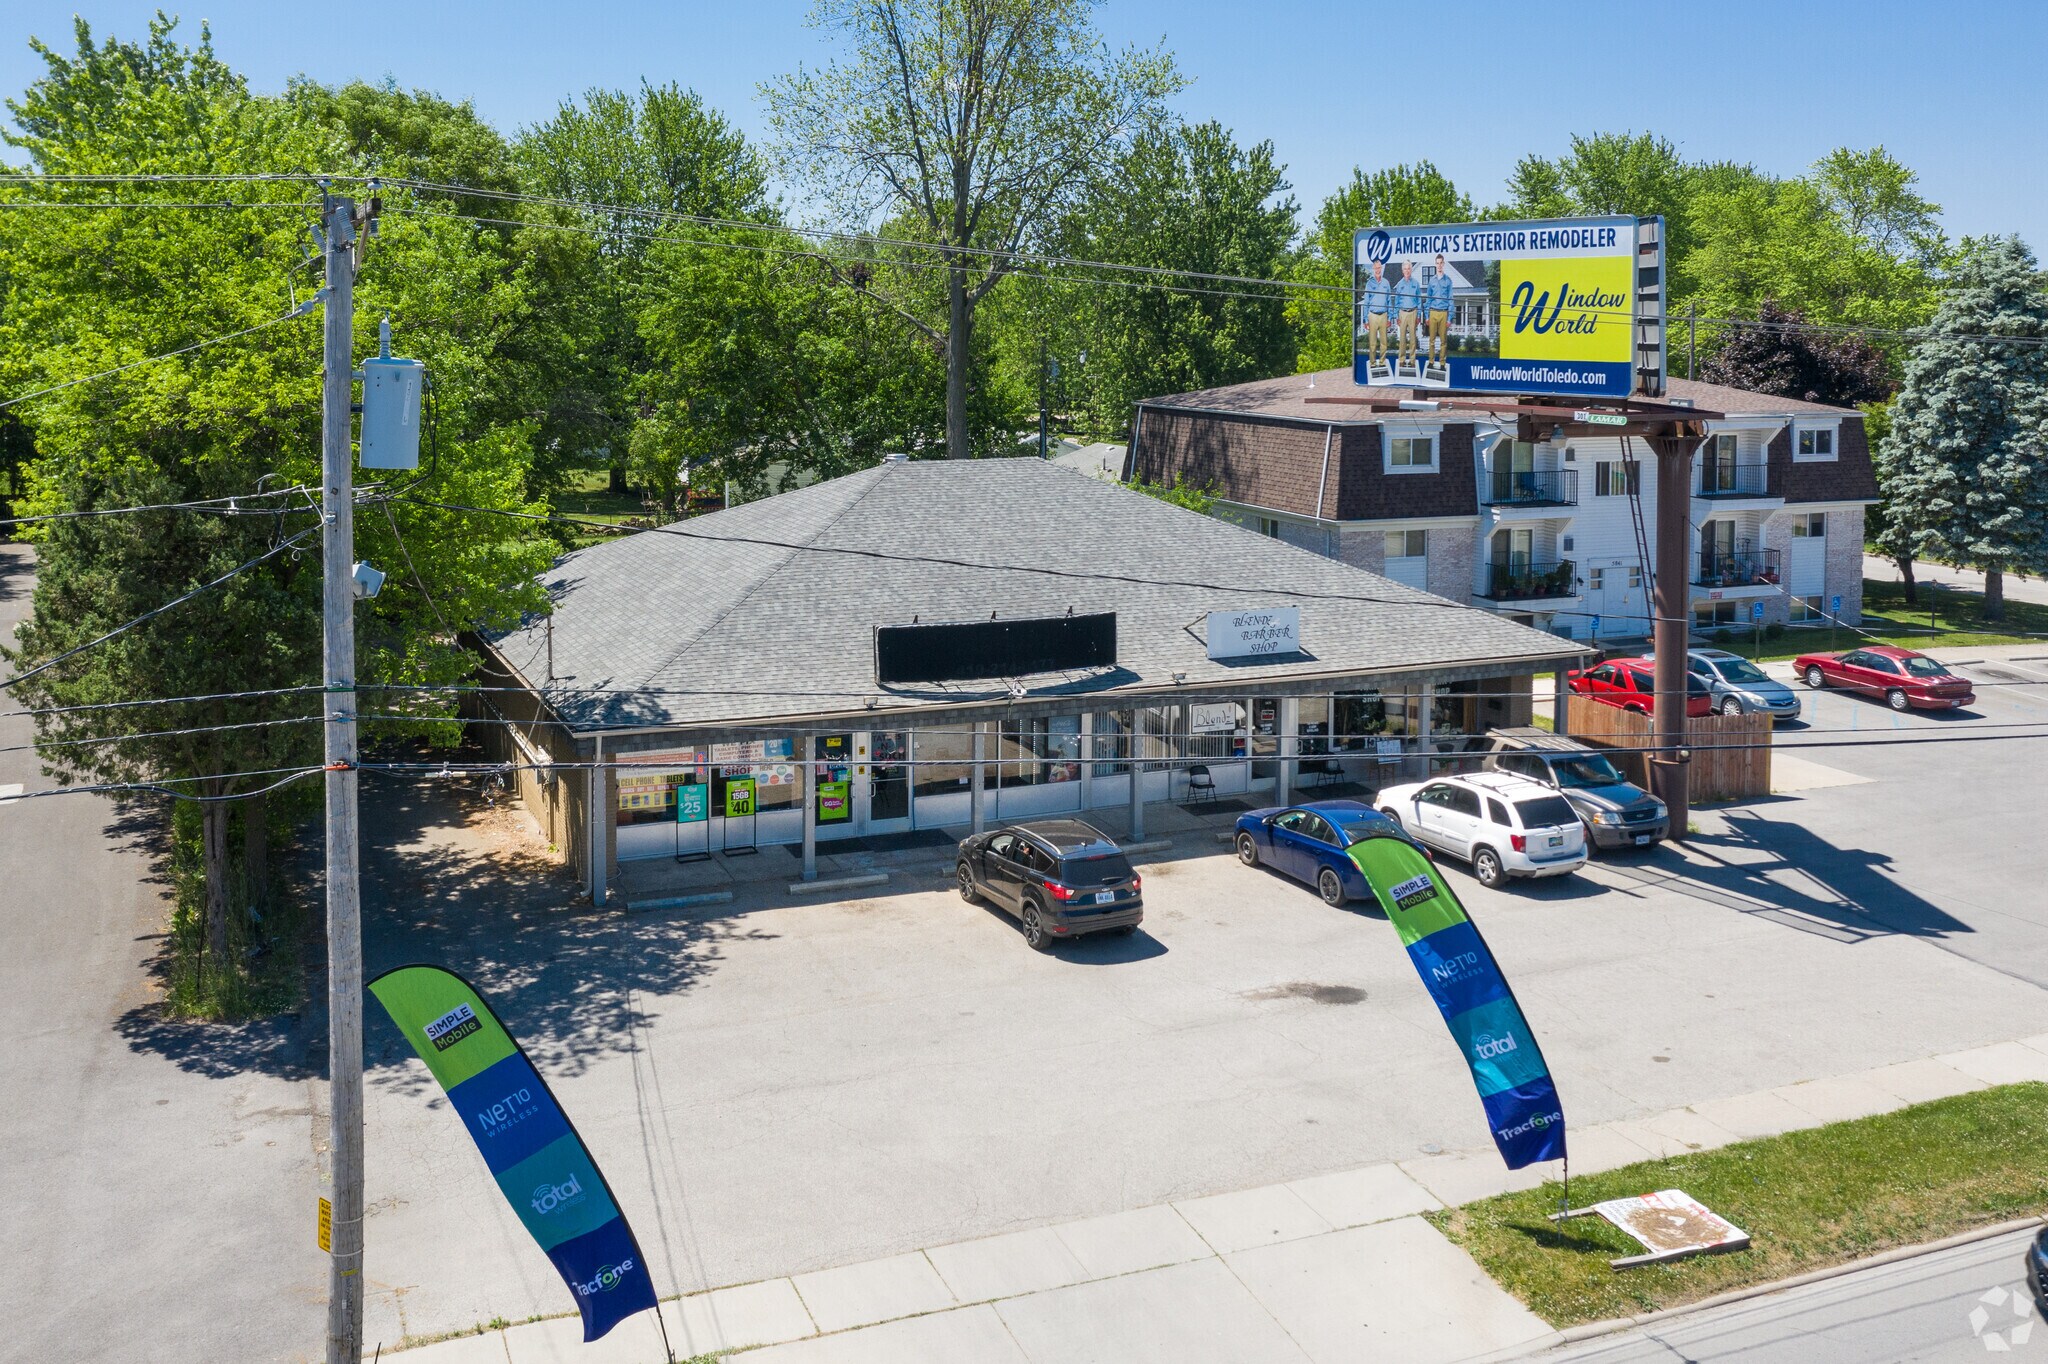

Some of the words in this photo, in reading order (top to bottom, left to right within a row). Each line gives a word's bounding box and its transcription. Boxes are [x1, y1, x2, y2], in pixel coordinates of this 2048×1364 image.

[1395, 234, 1460, 255] AMERICA'S
[1463, 232, 1526, 252] EXTERIOR
[1530, 228, 1616, 249] REMODELER
[1511, 281, 1626, 334] Window
[1471, 365, 1606, 385] WindowWorldToledo.com
[1591, 415, 1623, 424] LAMAR
[1241, 624, 1293, 641] BARBER
[1249, 641, 1278, 653] SHOP
[621, 778, 634, 787] CELL
[636, 776, 655, 786] PHONE
[660, 774, 683, 784] TABLETS
[725, 767, 753, 776] SHOP
[732, 791, 749, 800] 15GB
[680, 801, 700, 814] $25
[731, 800, 749, 814] $40
[1393, 876, 1430, 898] SIMPLE
[1400, 890, 1434, 909] Mobile
[1441, 967, 1484, 988] WIRELESS
[427, 1006, 471, 1037] SIMPLE
[436, 1022, 477, 1048] Mobile
[1475, 1031, 1517, 1059] total
[487, 1105, 538, 1138] WIRELESS
[1498, 1111, 1561, 1141] Tracfone
[531, 1173, 582, 1214] total
